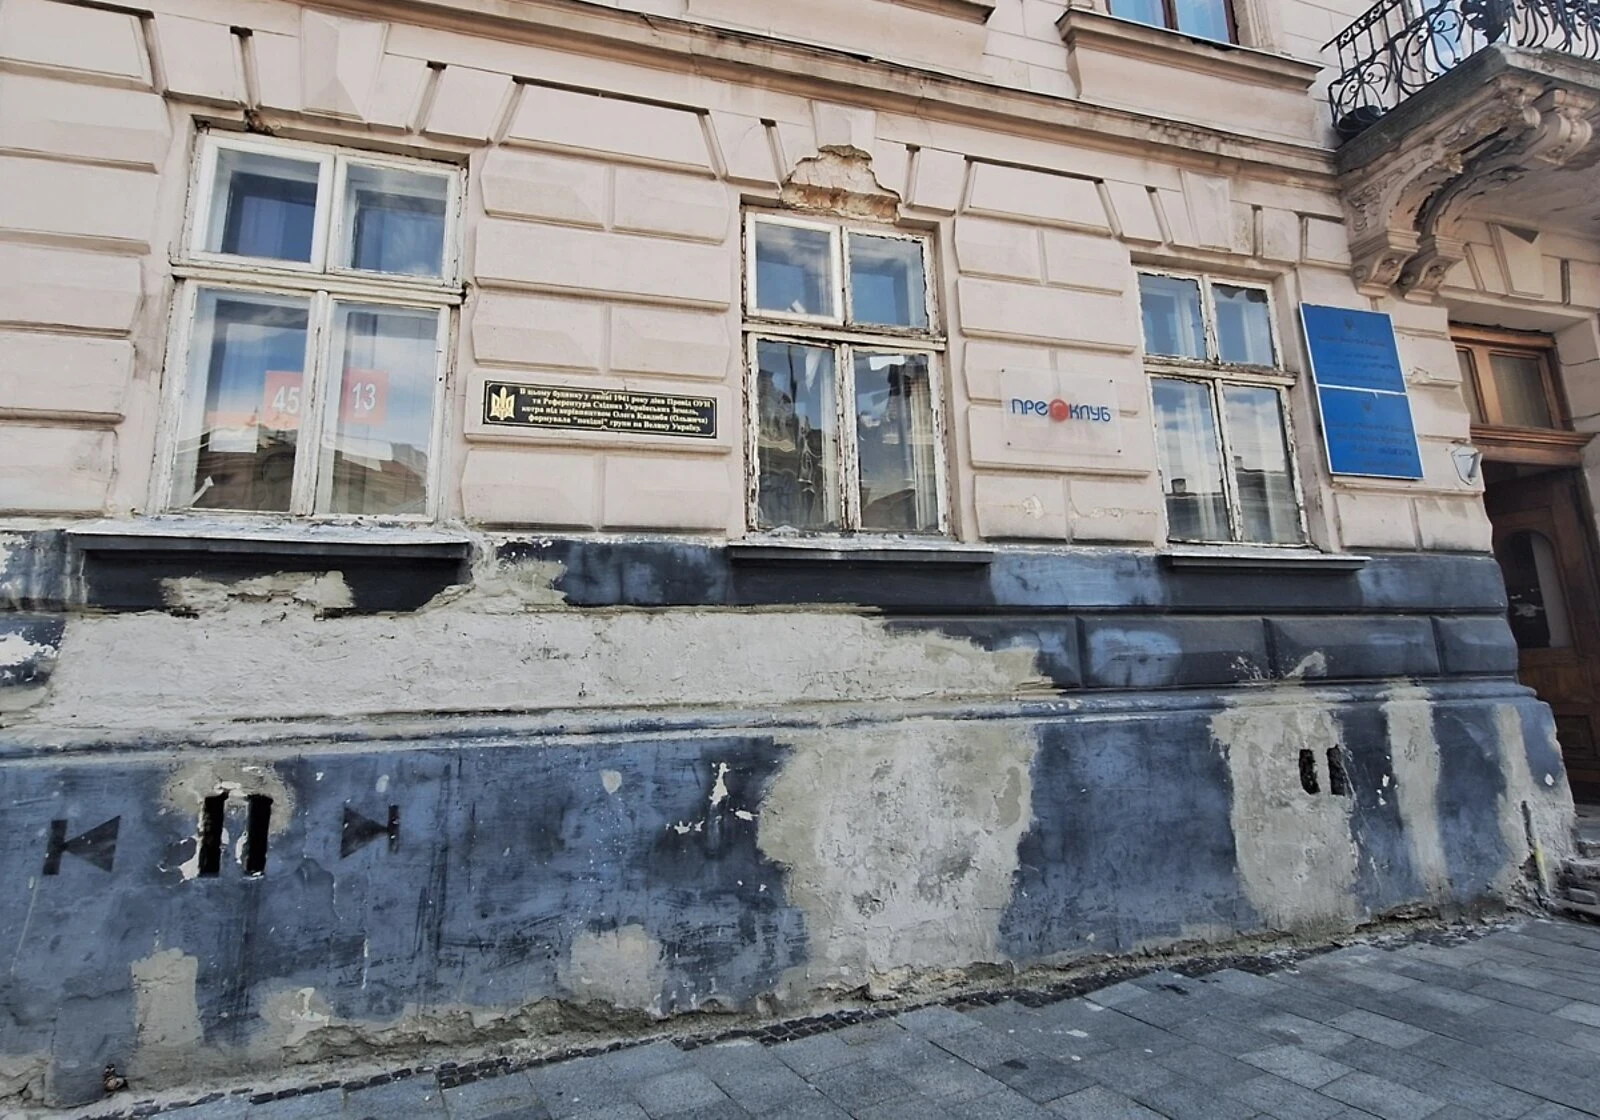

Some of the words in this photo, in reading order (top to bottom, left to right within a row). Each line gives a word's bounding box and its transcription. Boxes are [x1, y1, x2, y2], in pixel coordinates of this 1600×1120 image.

[272, 386, 300, 414] 45
[353, 383, 376, 410] 13
[520, 387, 526, 395] В
[553, 391, 582, 400] будинку
[614, 394, 629, 402] 1941
[631, 396, 649, 405] року
[693, 400, 710, 408] ОУН
[544, 398, 591, 408] Референтура
[625, 403, 670, 412] Українських
